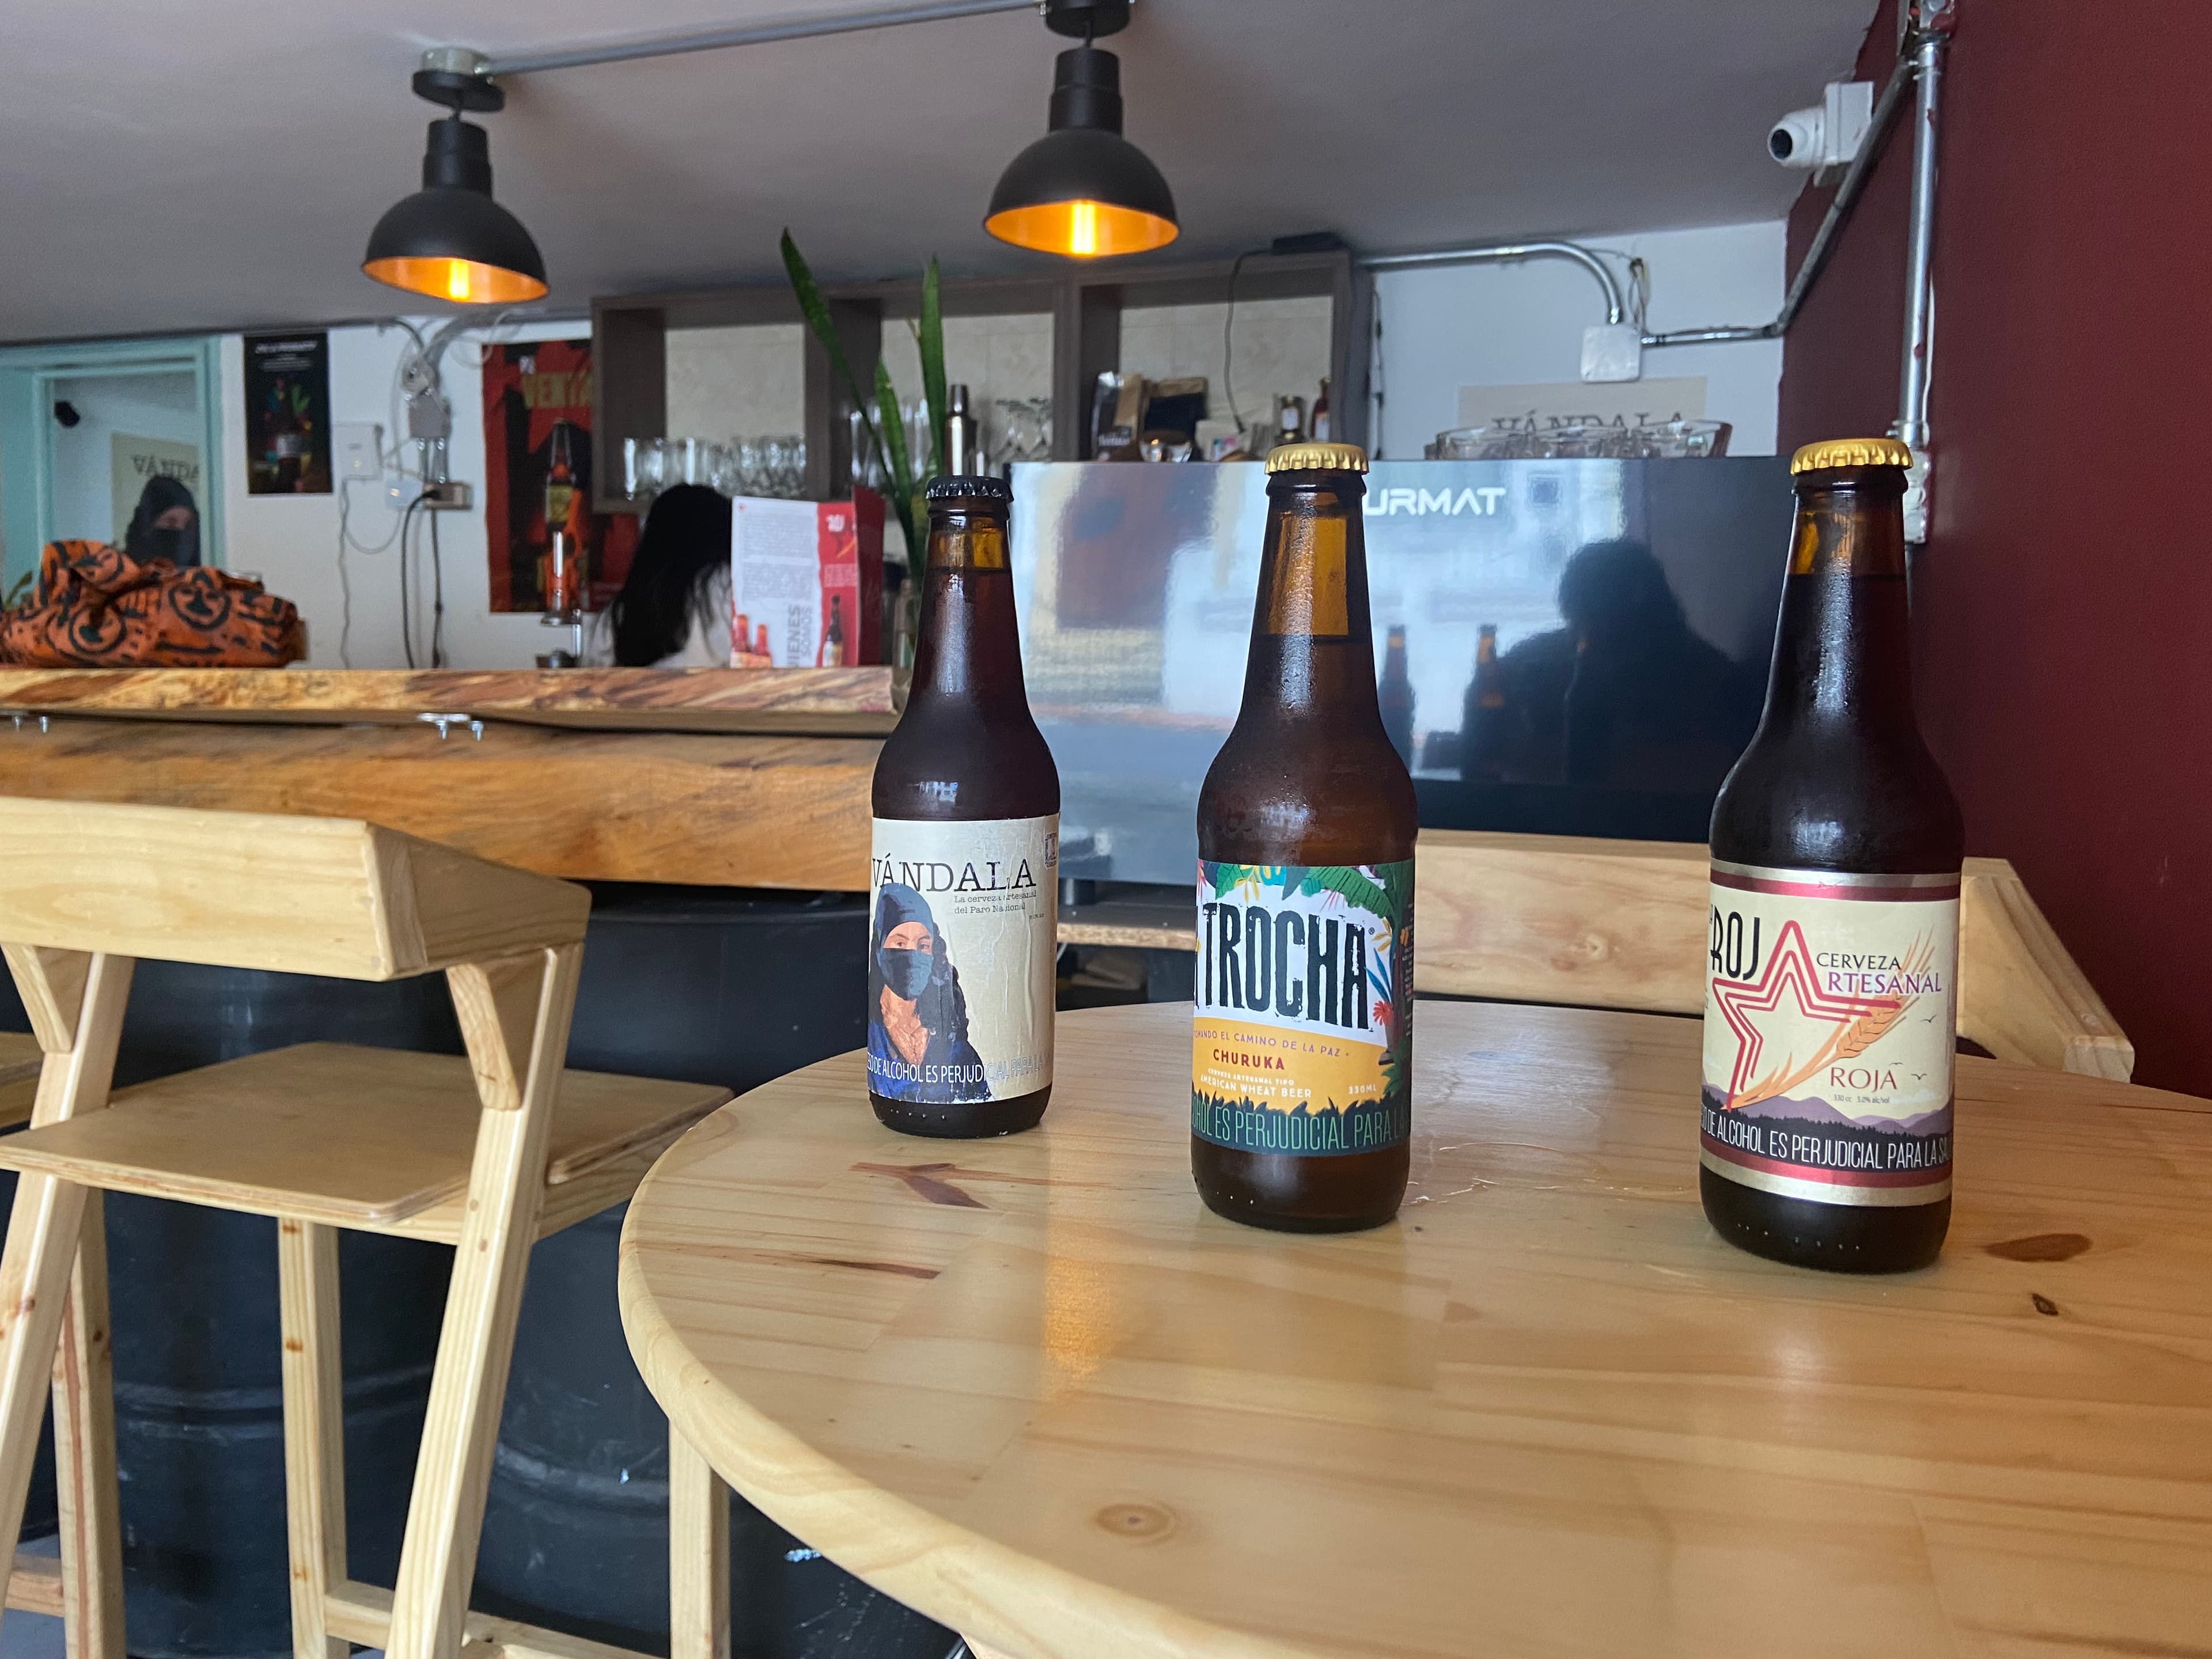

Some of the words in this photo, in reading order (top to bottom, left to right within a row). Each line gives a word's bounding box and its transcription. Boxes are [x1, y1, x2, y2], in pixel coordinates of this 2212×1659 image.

[873, 853, 1037, 892] VÁNDALA
[1202, 899, 1374, 1032] TROCHA
[1816, 952, 1902, 970] CERVEZA
[1221, 1031, 1229, 1040] EL
[1234, 1033, 1277, 1047] CAMINO
[1282, 1040, 1297, 1050] DE
[1302, 1043, 1315, 1054] LA
[1320, 1046, 1340, 1057] PAZ
[874, 1056, 881, 1075] DE
[882, 1059, 923, 1082] ALCOHOL
[926, 1065, 938, 1084] ES
[941, 1060, 1009, 1084] PERJUDICIAL
[1213, 1048, 1285, 1070] CHURUKA
[1200, 1074, 1237, 1091] AMERICAN
[1240, 1083, 1277, 1097] WHEAT
[1281, 1088, 1312, 1098] BEER
[1831, 1067, 1897, 1093] ROJA
[1215, 1106, 1230, 1141] ES
[1236, 1110, 1350, 1150] PERJUDICIAL
[1354, 1108, 1392, 1147] PARA
[1717, 1115, 1765, 1154] ALCOHOL
[1770, 1130, 1787, 1159] ES
[1791, 1134, 1883, 1169] PERJUDICIAL
[1888, 1141, 1922, 1169] PARA
[1925, 1139, 1936, 1166] LA
